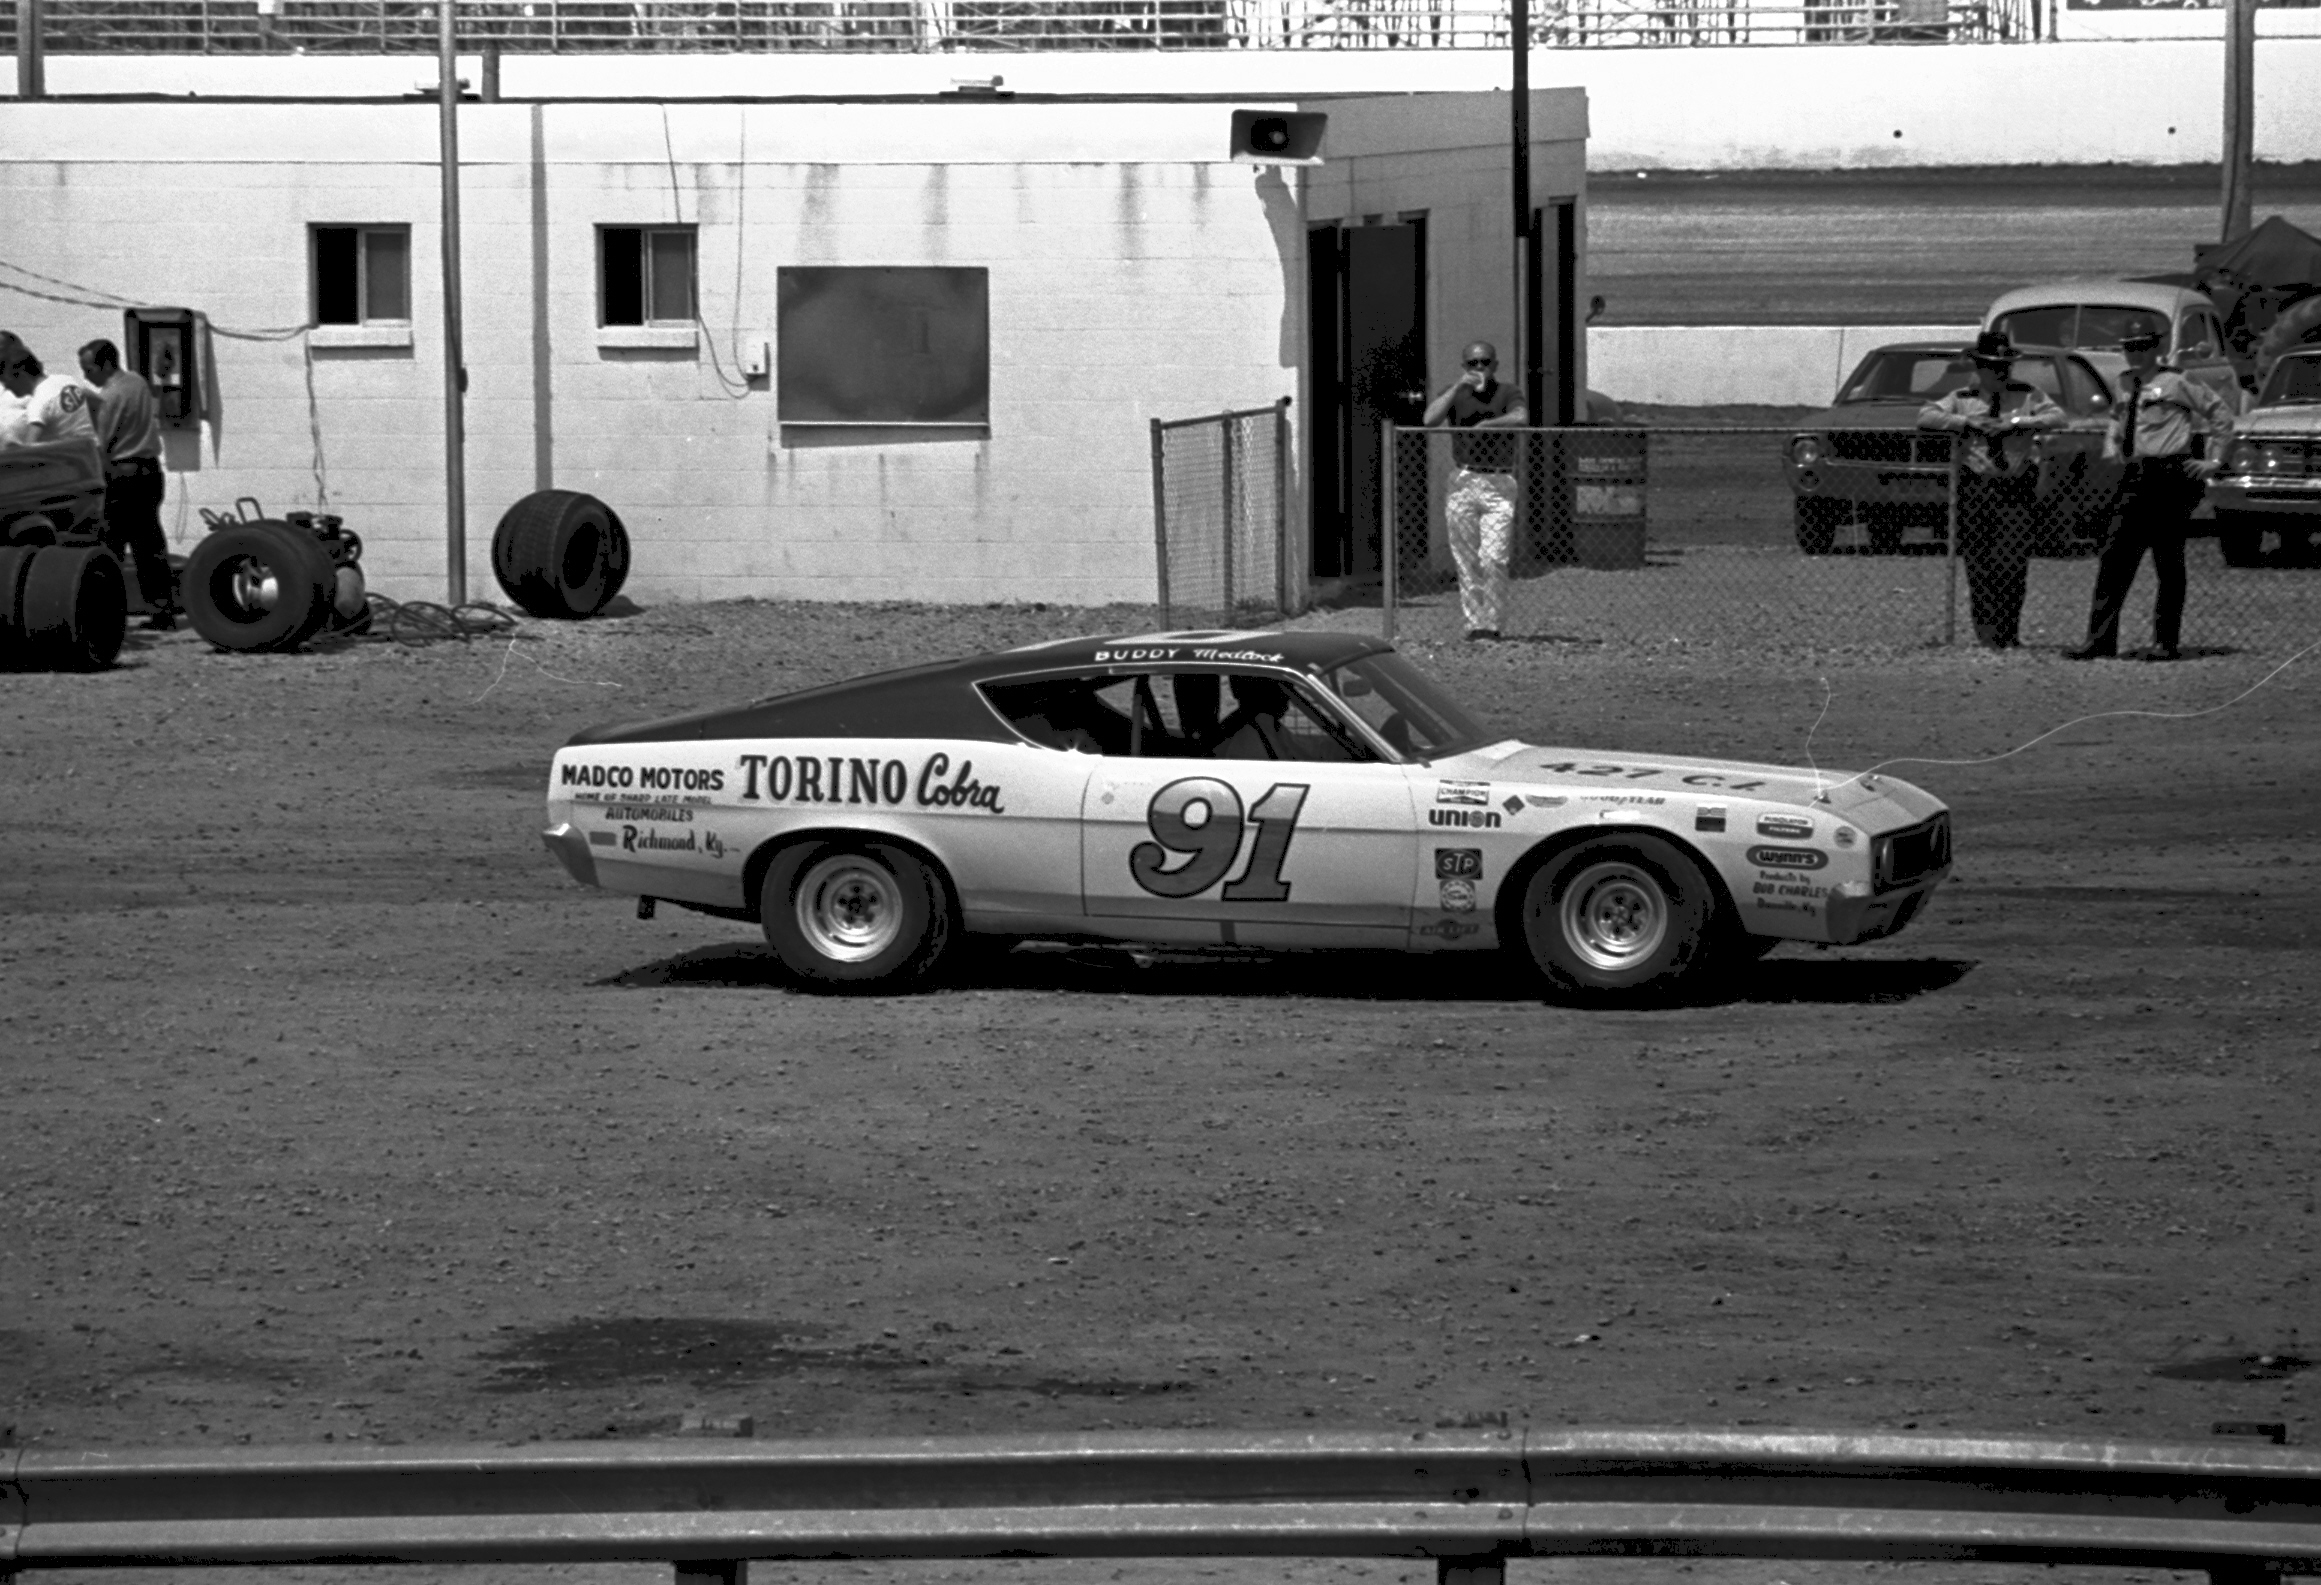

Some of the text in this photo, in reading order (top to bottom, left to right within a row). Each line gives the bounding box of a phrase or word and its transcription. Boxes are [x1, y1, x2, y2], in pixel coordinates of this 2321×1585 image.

[1094, 648, 1181, 661] BUDDY
[562, 764, 724, 791] MADCO MOTORS
[1539, 763, 1664, 779] 427
[740, 752, 1004, 814] TORINO Cobra
[1441, 787, 1486, 797] CHAMPION
[605, 807, 694, 821] AUTOMOBILES
[1128, 776, 1311, 902] 91
[1443, 852, 1475, 873] STP
[1778, 885, 1828, 898] CHARLES
